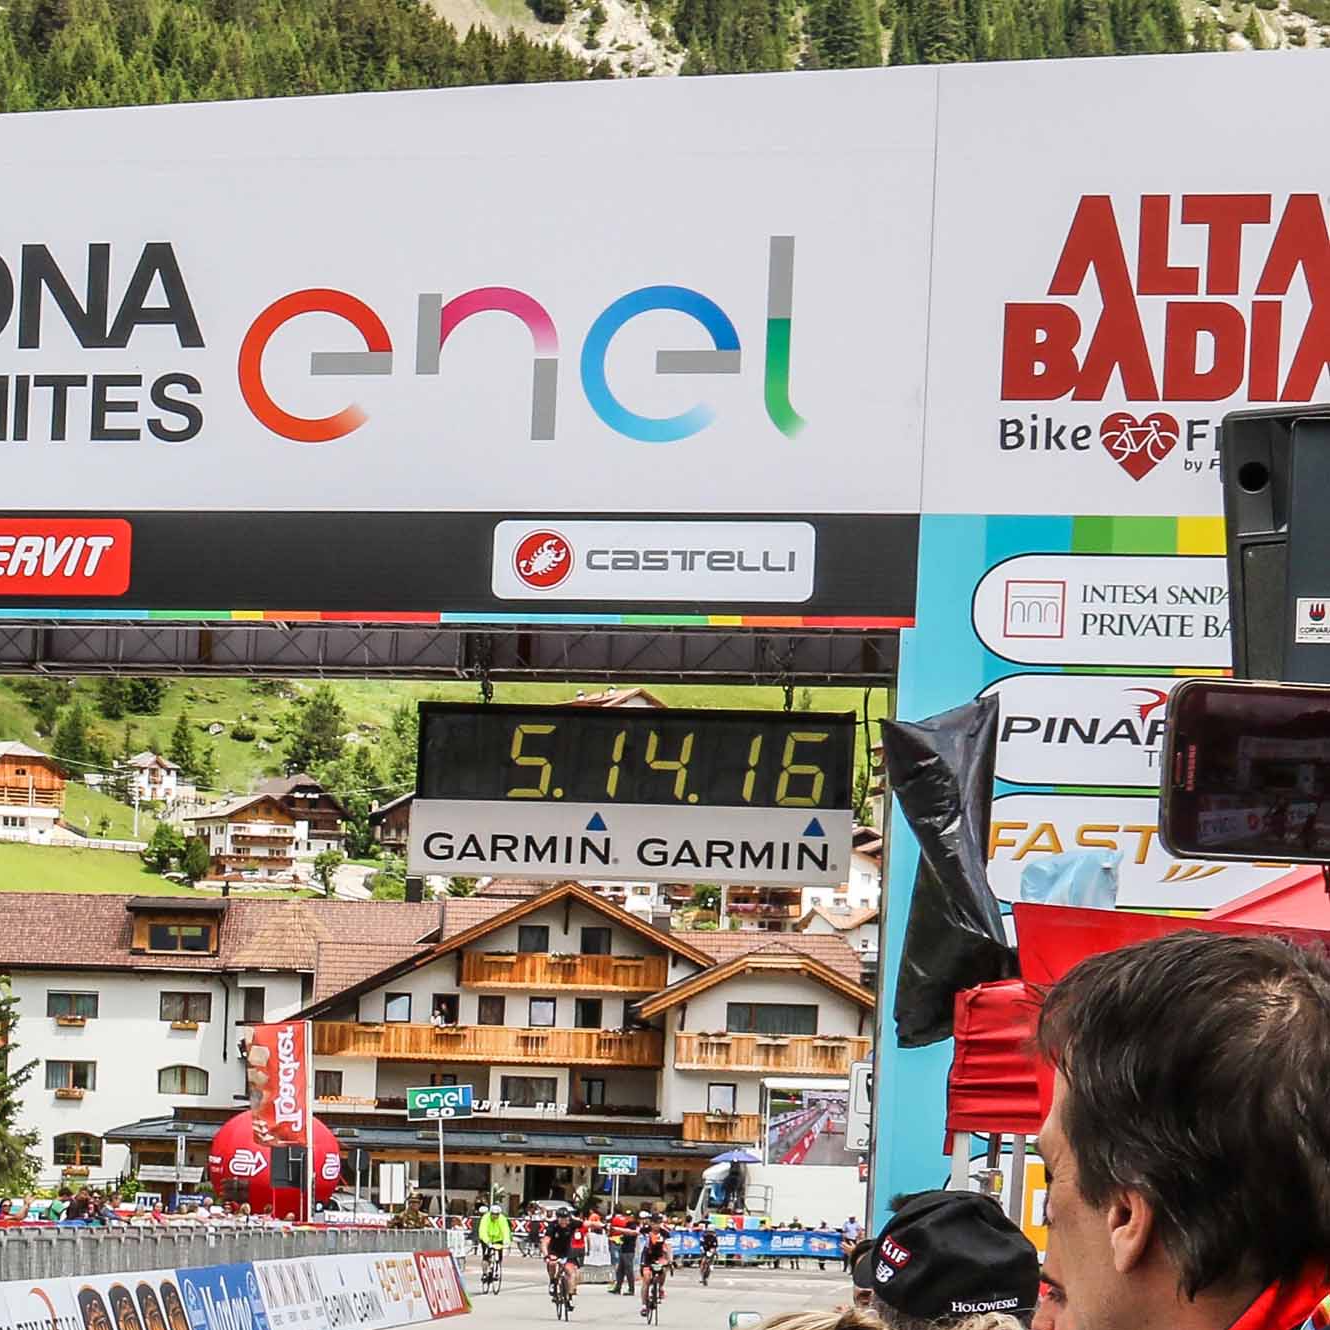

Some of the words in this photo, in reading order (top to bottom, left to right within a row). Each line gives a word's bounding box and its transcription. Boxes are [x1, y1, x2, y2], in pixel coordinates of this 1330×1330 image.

[1047, 194, 1330, 296] ALTA
[238, 235, 808, 443] enel
[999, 414, 1091, 452] Bike
[1183, 458, 1203, 473] by
[1082, 584, 1157, 605] INTESA
[1081, 613, 1193, 638] PRIVATE
[424, 832, 611, 865] GARMIN
[637, 838, 829, 871] GARMIN
[415, 1087, 463, 1109] enel
[426, 1108, 455, 1118] 50
[605, 1156, 634, 1167] enel
